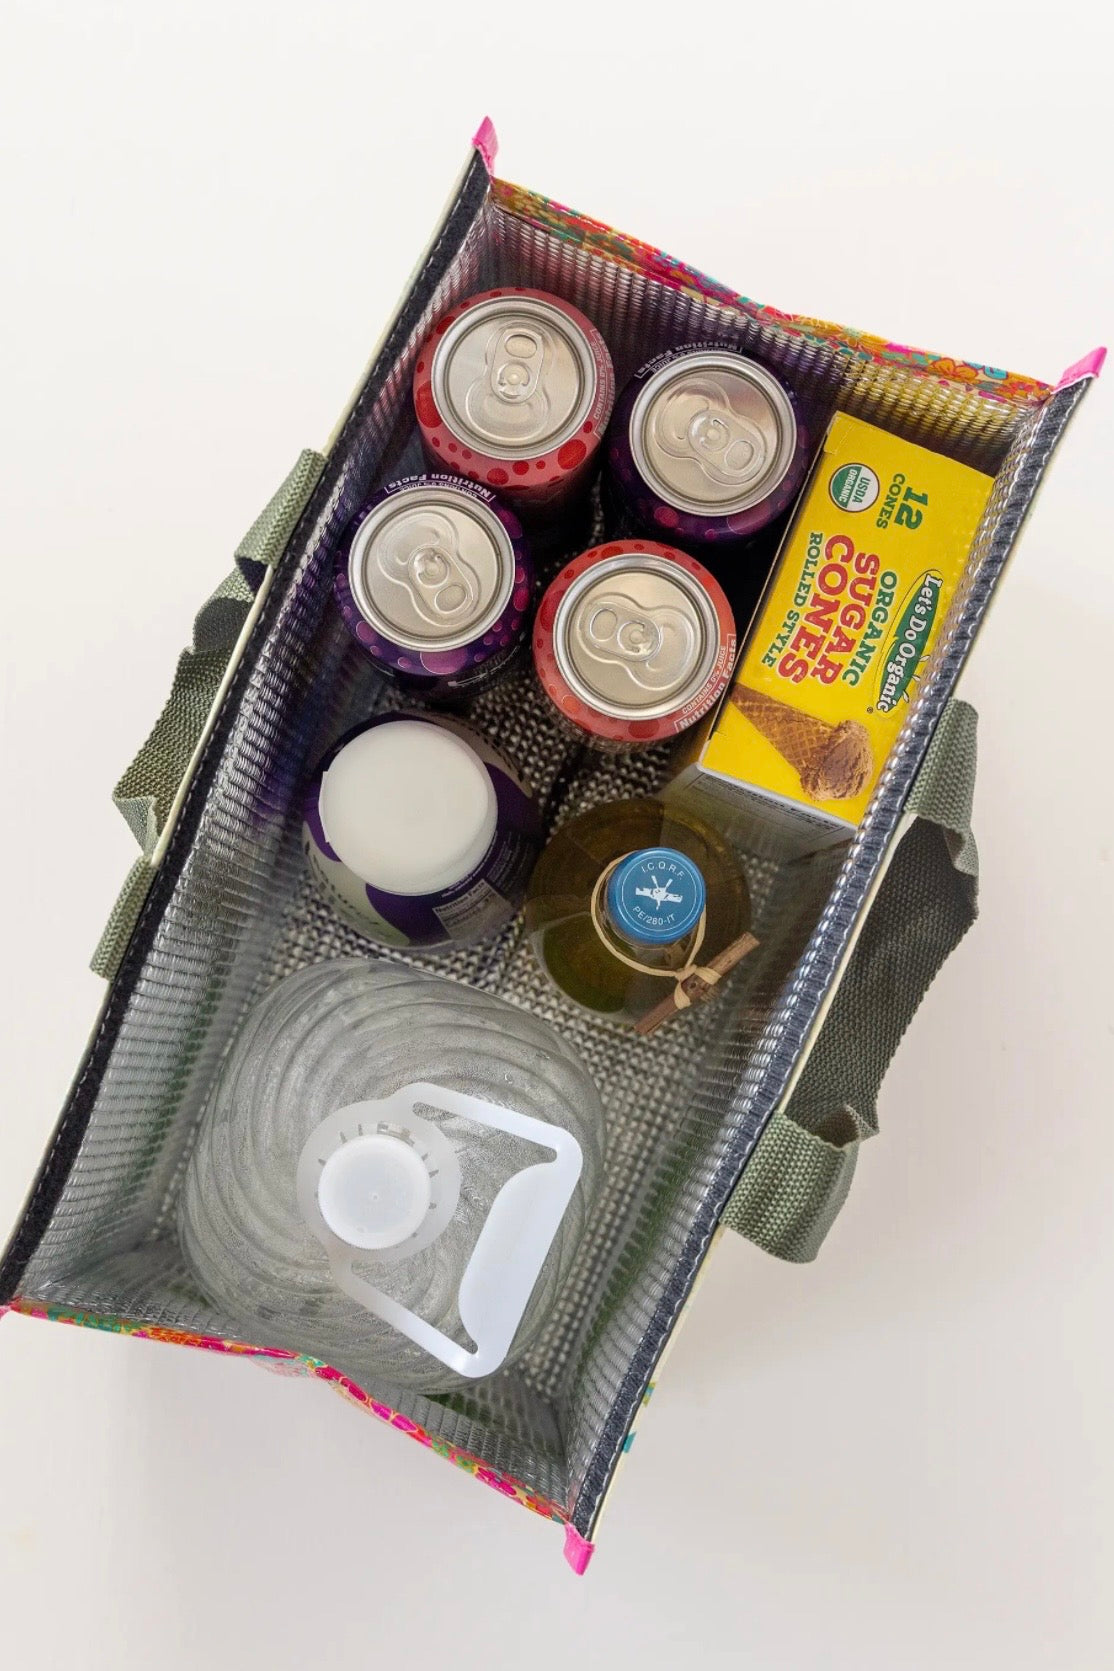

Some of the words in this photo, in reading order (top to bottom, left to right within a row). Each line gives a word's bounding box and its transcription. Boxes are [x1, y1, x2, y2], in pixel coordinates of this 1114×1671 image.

[388, 474, 427, 489] Facts
[431, 473, 492, 499] Nutrition
[838, 468, 858, 503] ORGANIC
[852, 476, 871, 503] USDA
[876, 473, 906, 529] CONES
[893, 486, 929, 530] 12
[793, 532, 823, 607] ROLLED
[914, 573, 943, 615] Let's
[778, 534, 855, 684] CONES
[811, 552, 880, 684] SUGAR
[842, 571, 898, 687] ORGANIC
[904, 615, 927, 641] Do
[762, 610, 800, 667] STYLE
[680, 682, 726, 730] Nutrition
[722, 639, 737, 680] Facts
[682, 684, 713, 715] CONTAINS
[718, 645, 727, 668] JUICE
[876, 642, 917, 714] Organic
